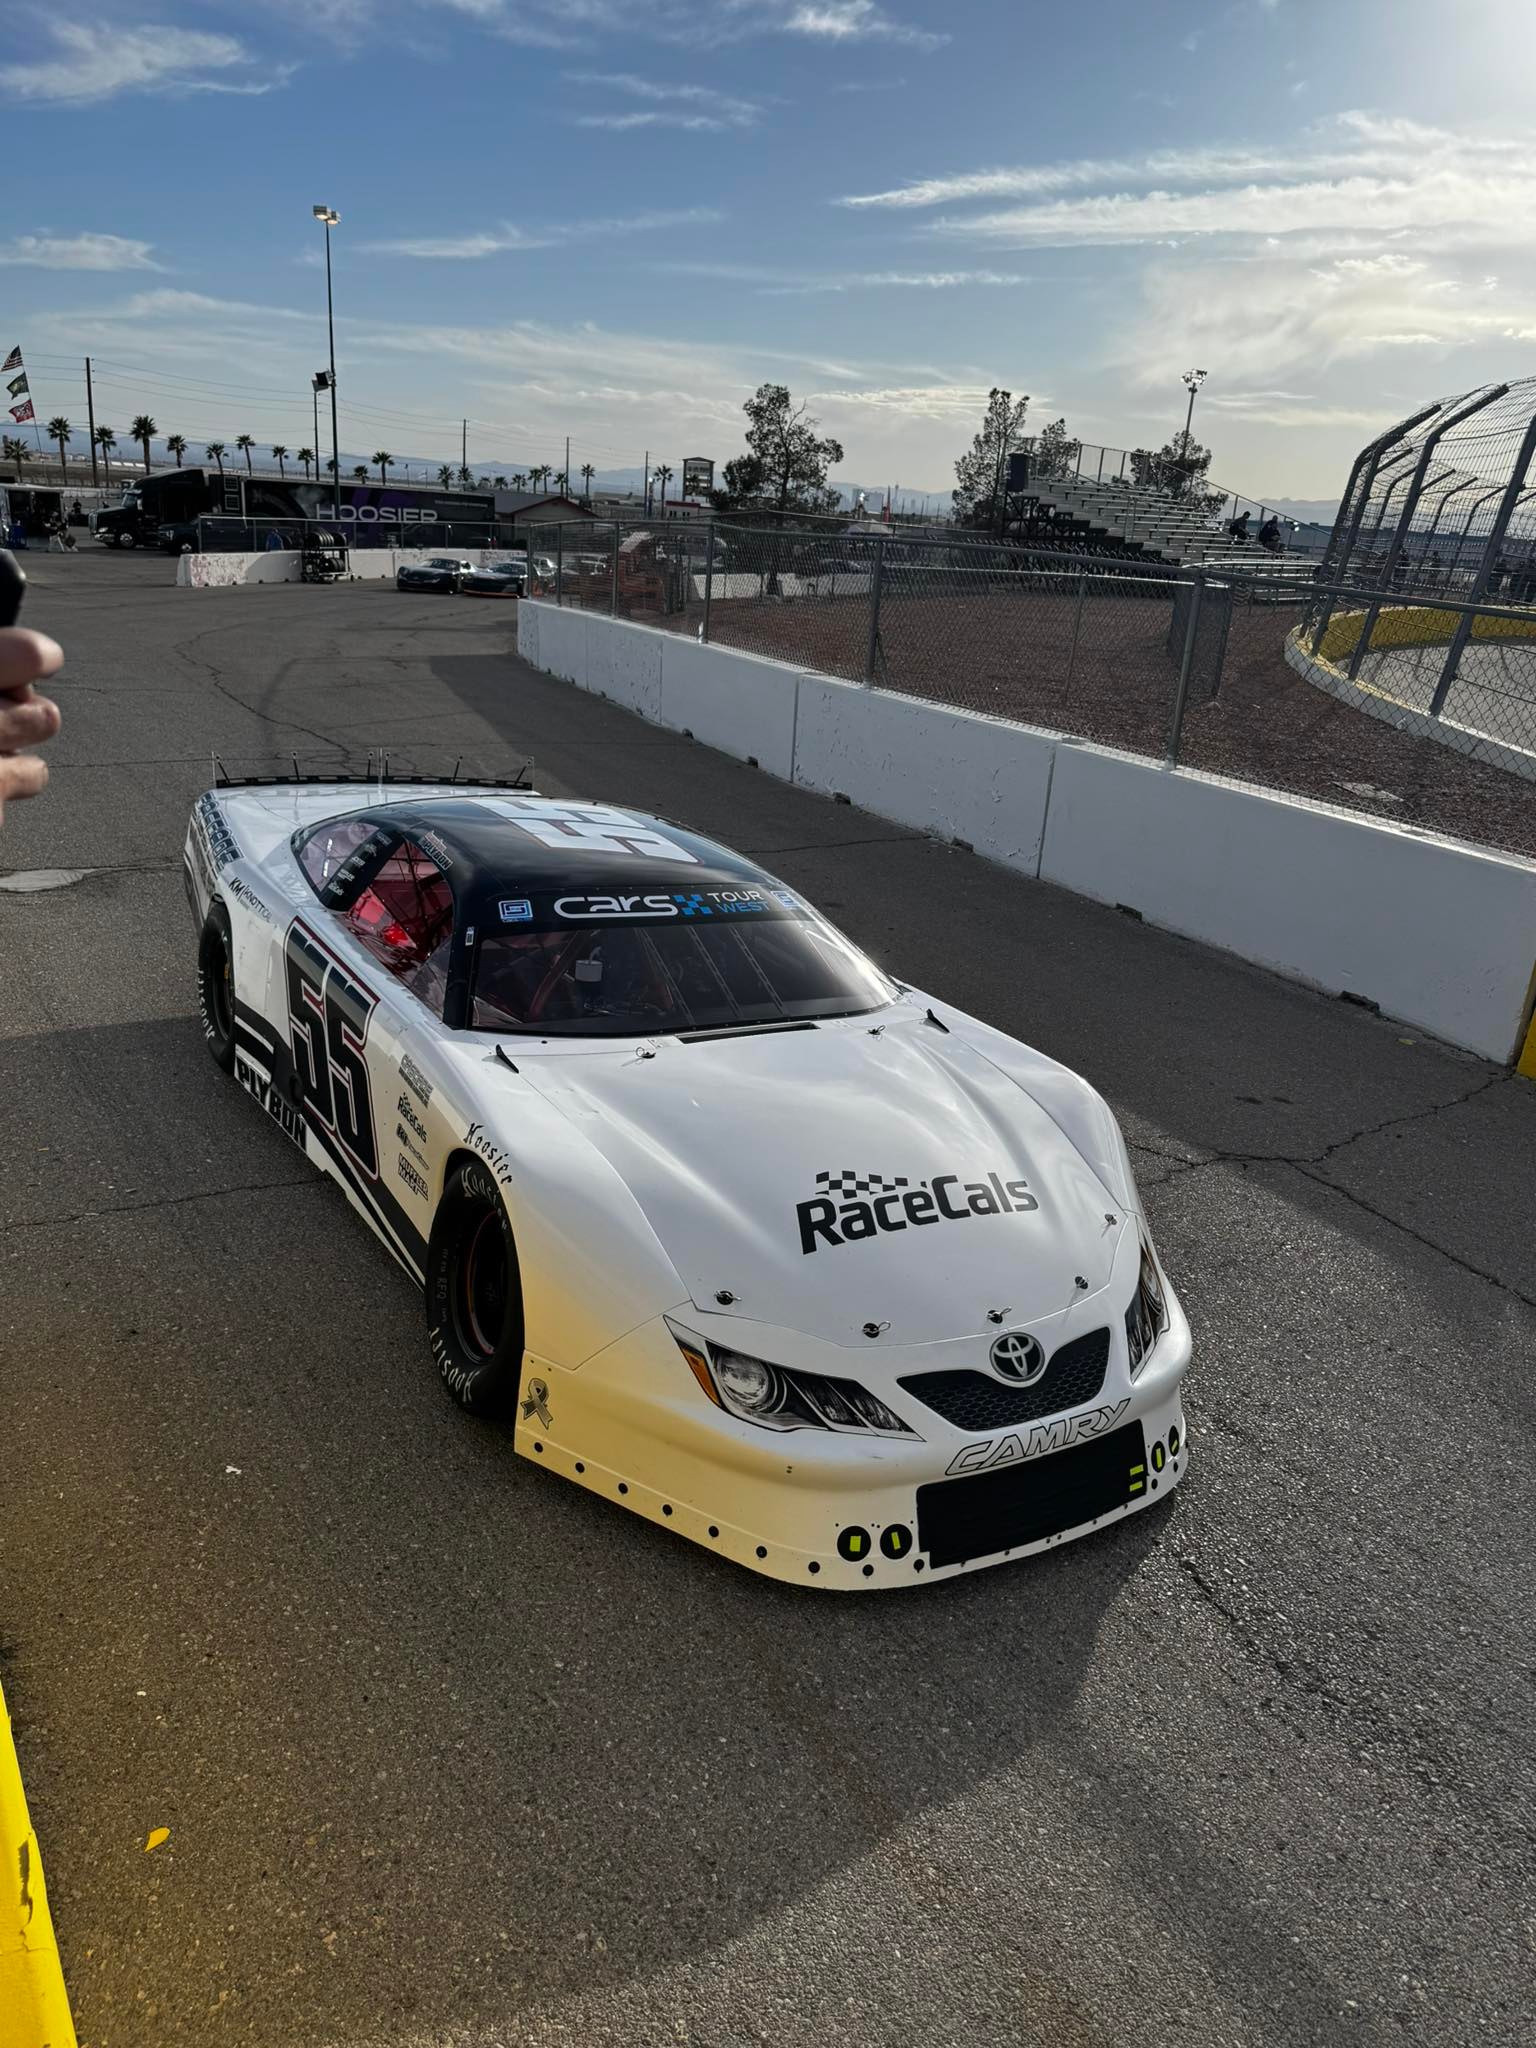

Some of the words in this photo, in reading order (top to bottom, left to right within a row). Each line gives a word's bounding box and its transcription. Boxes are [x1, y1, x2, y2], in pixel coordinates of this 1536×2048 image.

[316, 504, 438, 522] HOOSIER
[707, 890, 764, 903] TOUR
[716, 901, 771, 913] WEST
[284, 917, 380, 1180] 55
[463, 1122, 513, 1185] Hoosier
[796, 1172, 1039, 1255] RaceCals
[945, 1398, 1131, 1476] CAMRY
